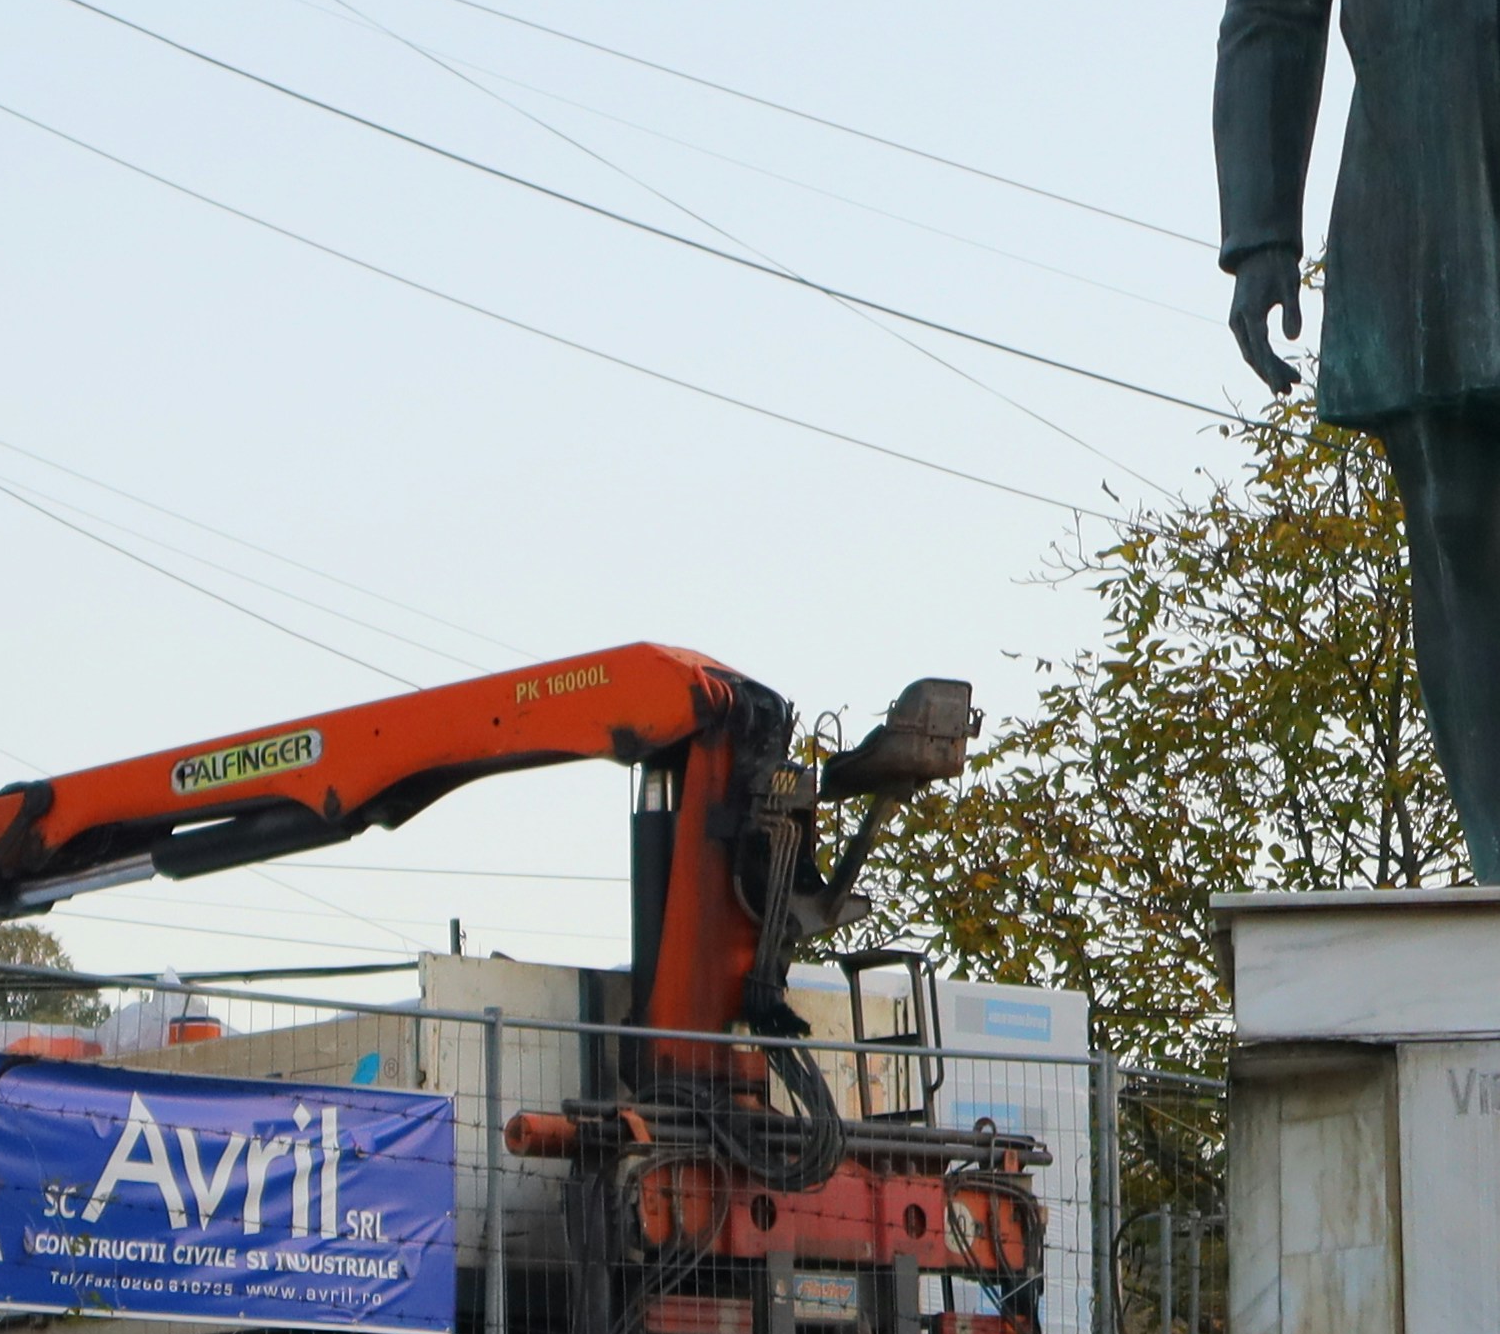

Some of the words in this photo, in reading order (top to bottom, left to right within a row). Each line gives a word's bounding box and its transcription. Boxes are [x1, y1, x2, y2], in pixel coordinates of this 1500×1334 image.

[516, 679, 540, 704] PK
[546, 664, 610, 696] 16000L
[175, 734, 313, 790] PALFINGER
[43, 1184, 78, 1220] SC
[80, 1090, 340, 1240] Avril
[345, 1210, 389, 1243] SRL
[35, 1234, 167, 1264] CONSTRUCTII
[173, 1245, 236, 1268] CIVILE
[246, 1251, 269, 1269] SI
[274, 1251, 399, 1279] INDUSTRIALE
[246, 1284, 383, 1307] www.avril.ro
